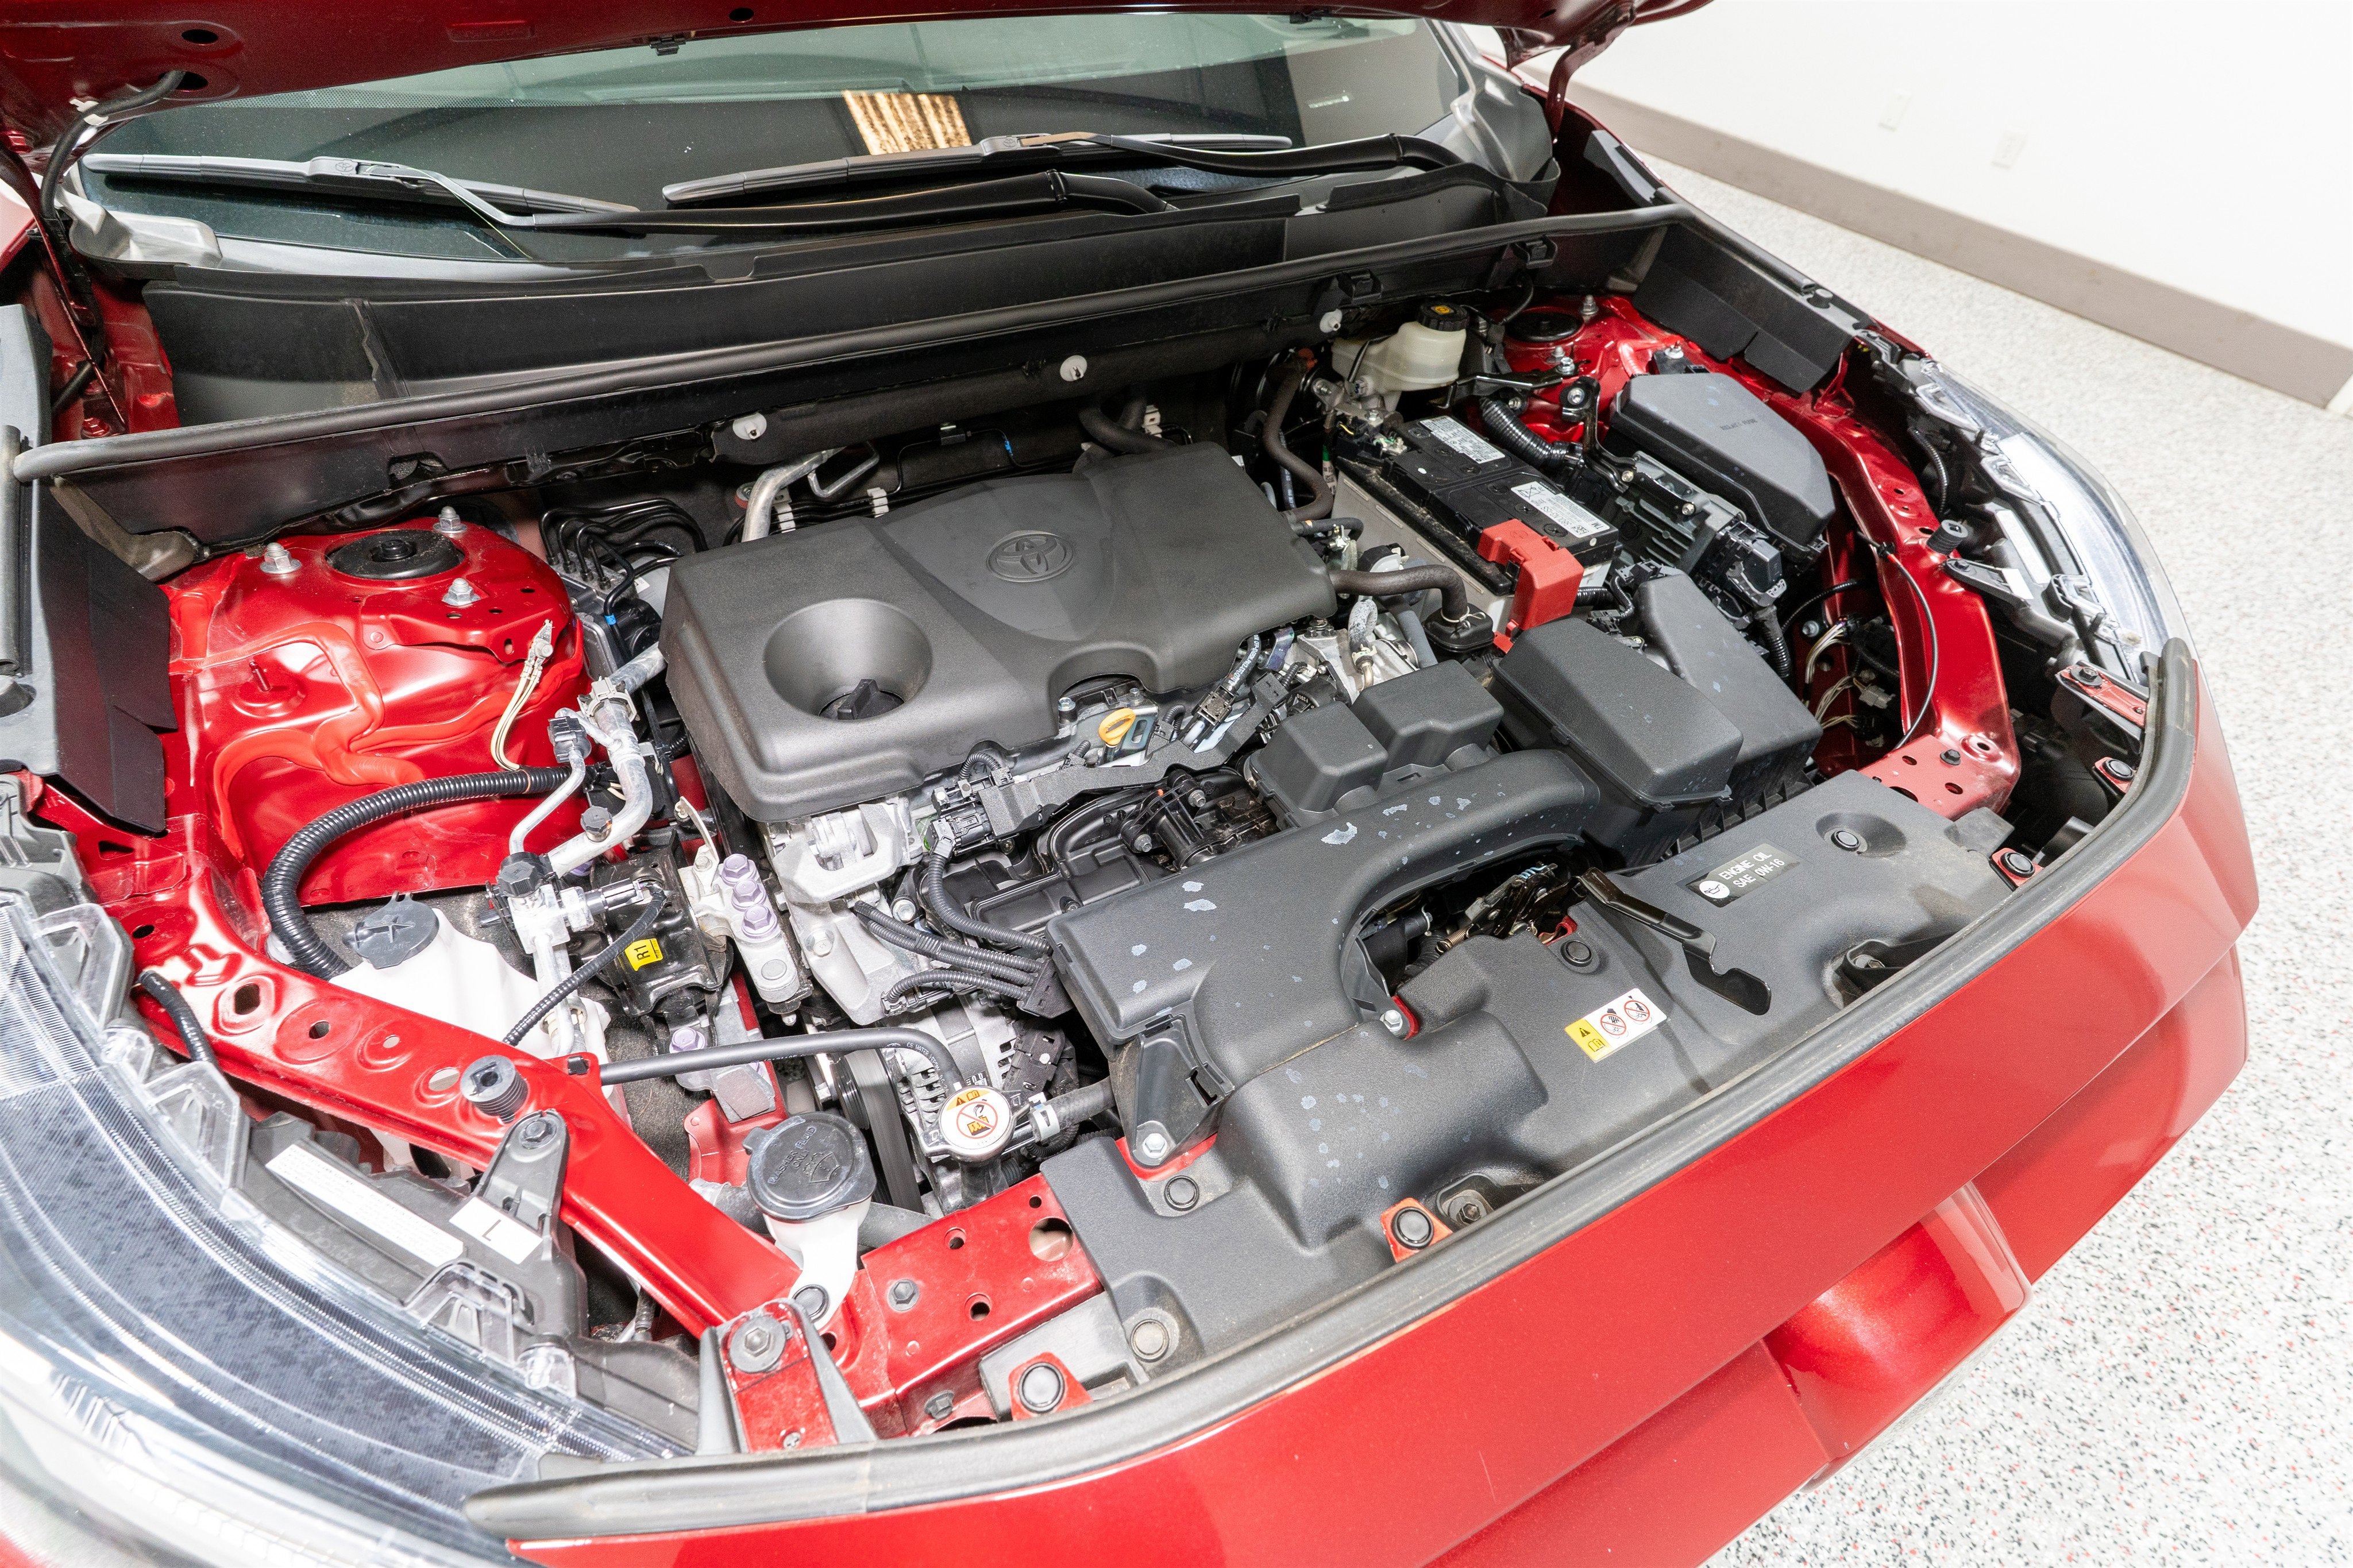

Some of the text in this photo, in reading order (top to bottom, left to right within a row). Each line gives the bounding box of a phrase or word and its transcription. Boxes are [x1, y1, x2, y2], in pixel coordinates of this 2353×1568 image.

[1718, 852, 1772, 880] ENGINE OIL
[1733, 858, 1785, 888] SAE 0W-16
[634, 945, 651, 961] R1
[767, 1125, 817, 1185] WASHER FLUID
[793, 1149, 810, 1169] ONLY
[481, 1218, 502, 1242] L
